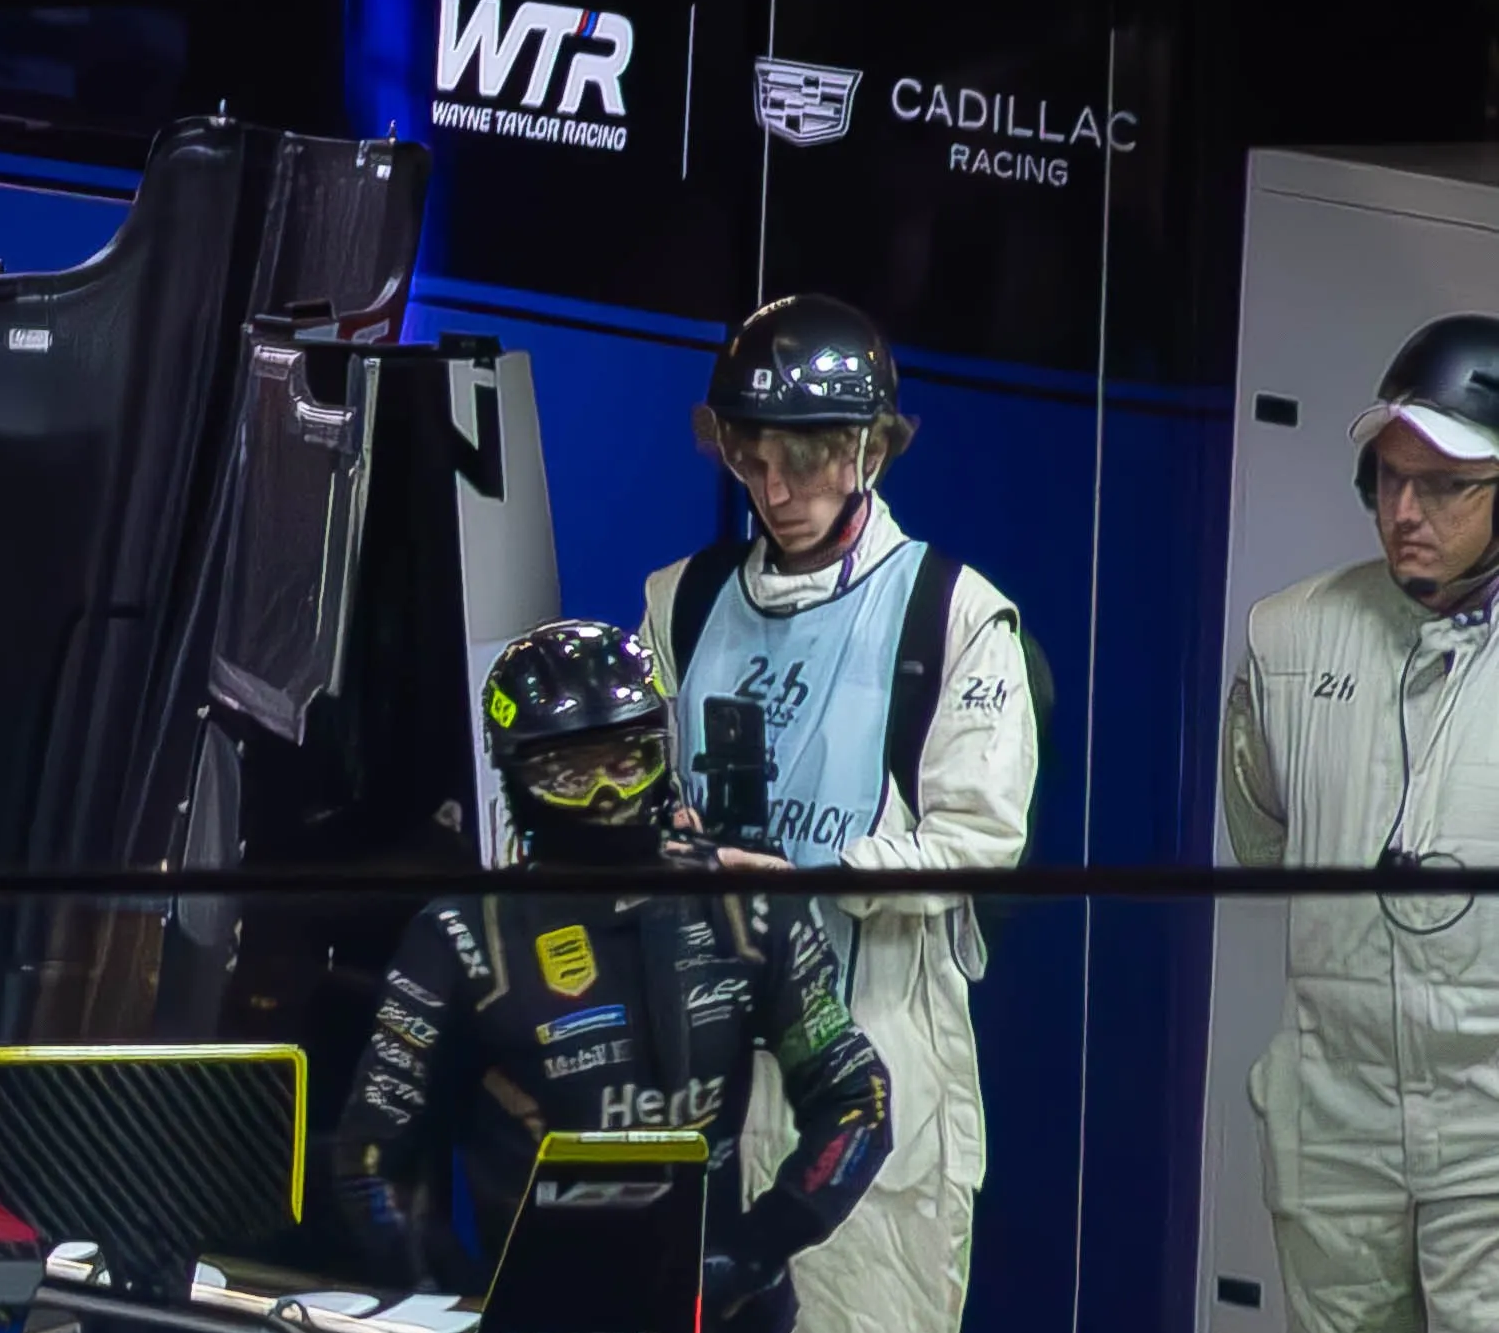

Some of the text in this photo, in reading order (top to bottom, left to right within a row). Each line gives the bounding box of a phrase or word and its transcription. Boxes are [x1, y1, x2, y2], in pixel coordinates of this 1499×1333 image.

[431, 99, 629, 153] WAYNE TAYLOR RACING
[889, 77, 1139, 154] CADILLAC
[948, 144, 1070, 189] RACING
[734, 654, 810, 708] 24h
[599, 1074, 729, 1129] Hertz
